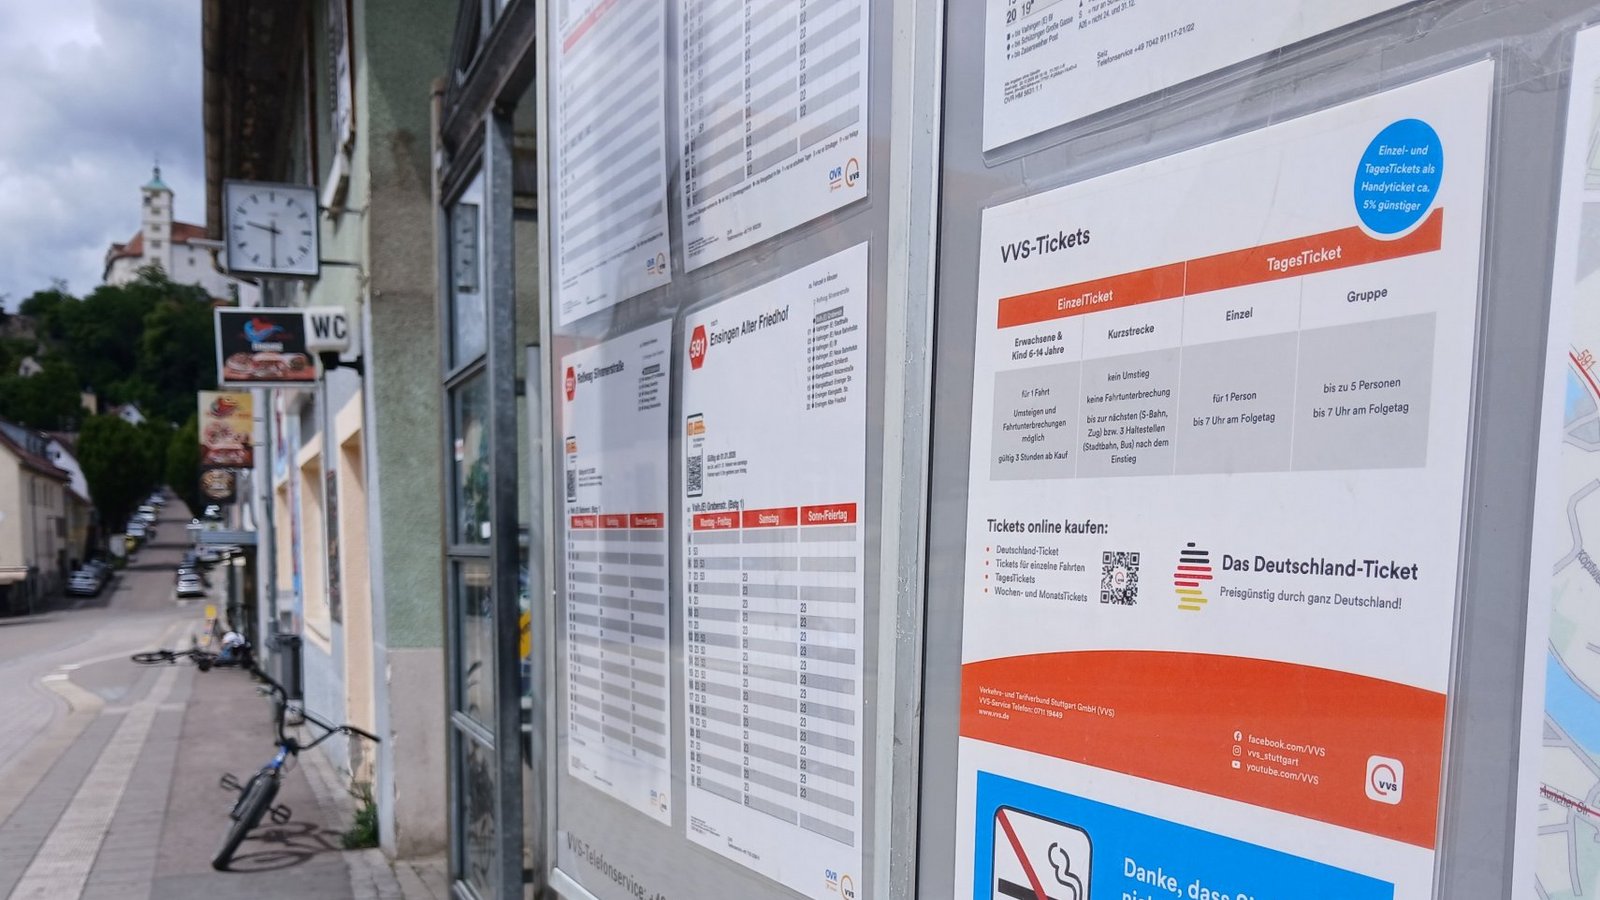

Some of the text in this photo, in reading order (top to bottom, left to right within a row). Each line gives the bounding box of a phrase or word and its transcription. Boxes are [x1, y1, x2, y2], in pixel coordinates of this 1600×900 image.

[1006, 8, 1016, 24] 20
[1096, 48, 1133, 67] Telefonservice
[1146, 37, 1158, 48] 7042
[1160, 22, 1194, 43] 91117-21/22
[1378, 145, 1429, 156] Einzel- und
[829, 167, 842, 180] OVR
[1365, 164, 1436, 176] TagesTickets als
[1362, 182, 1430, 194] Handyticket ca.
[1363, 200, 1421, 212] 5% günstiger
[1000, 228, 1090, 263] VVS-Tickets
[1267, 246, 1342, 272] TagesTicket
[1057, 290, 1114, 310] EinzelTicket
[1346, 288, 1388, 302] Gruppe
[1226, 307, 1253, 321] Einzel
[312, 314, 347, 339] WC
[710, 305, 790, 346] Ensingen Alter Friedhof
[1108, 324, 1154, 340] Kurzstrecke
[1014, 331, 1062, 347] Erwachsene &
[690, 339, 705, 358] 591
[1012, 345, 1064, 360] Kind 6-14 Jahre
[1577, 349, 1596, 370] 591
[1108, 369, 1150, 382] kein Umstieg
[1022, 389, 1030, 398] für
[1034, 388, 1050, 397] Fahrt
[1323, 378, 1400, 394] bis zu 5 Personen
[1086, 388, 1170, 404] keine Fahrtunterbrechung
[1212, 394, 1224, 403] für
[1230, 392, 1257, 402] Person
[1014, 406, 1056, 418] Umsteigen und
[1086, 415, 1096, 424] bis
[1108, 411, 1138, 422] nächsten
[1139, 410, 1168, 420] (S-Bahn,
[1313, 402, 1409, 418] bis 7 Uhr am Folgetag
[1002, 418, 1066, 431] Fahrtunterbrechungen
[1193, 412, 1276, 426] bis 7 Uhr am Folgetag
[1088, 424, 1166, 438] Zug) bzw. 3 Haltestellen
[1022, 434, 1045, 444] möglich
[1082, 438, 1169, 452] (Stadtbahn, Bus) nach dem
[998, 454, 1014, 464] gültig
[1020, 453, 1044, 462] Stunden
[1045, 452, 1053, 460] ab
[1054, 450, 1068, 460] Kauf
[1110, 454, 1136, 464] Einstieg
[987, 518, 1108, 534] Tickets online kaufen:
[996, 545, 1059, 556] Deutschland-Ticket
[996, 559, 1086, 572] Tickets für einzelne Fahrten
[1222, 554, 1418, 580] Das Deutschland-Ticket
[995, 572, 1036, 584] TagesTickets
[994, 586, 1088, 602] Wochen- und MonatsTickets
[1220, 586, 1402, 610] Preisgünstig durch ganz Deutschland!
[979, 686, 1004, 696] Verkehrs-
[1016, 692, 1050, 706] Tarifverbund
[1050, 698, 1076, 710] Stuttgart
[1078, 703, 1096, 713] GmbH
[1097, 706, 1115, 718] (VVS)
[979, 697, 1063, 719] VVS-Service Telefon: 0711 19449
[978, 709, 1010, 720] www.vvs.de
[1248, 734, 1326, 757] facebook.com/VVS
[1248, 749, 1299, 766] vvs_stuttgart
[1246, 762, 1320, 785] youtube.com/VVS
[825, 869, 838, 882] OVR
[1124, 857, 1182, 898] Danke,
